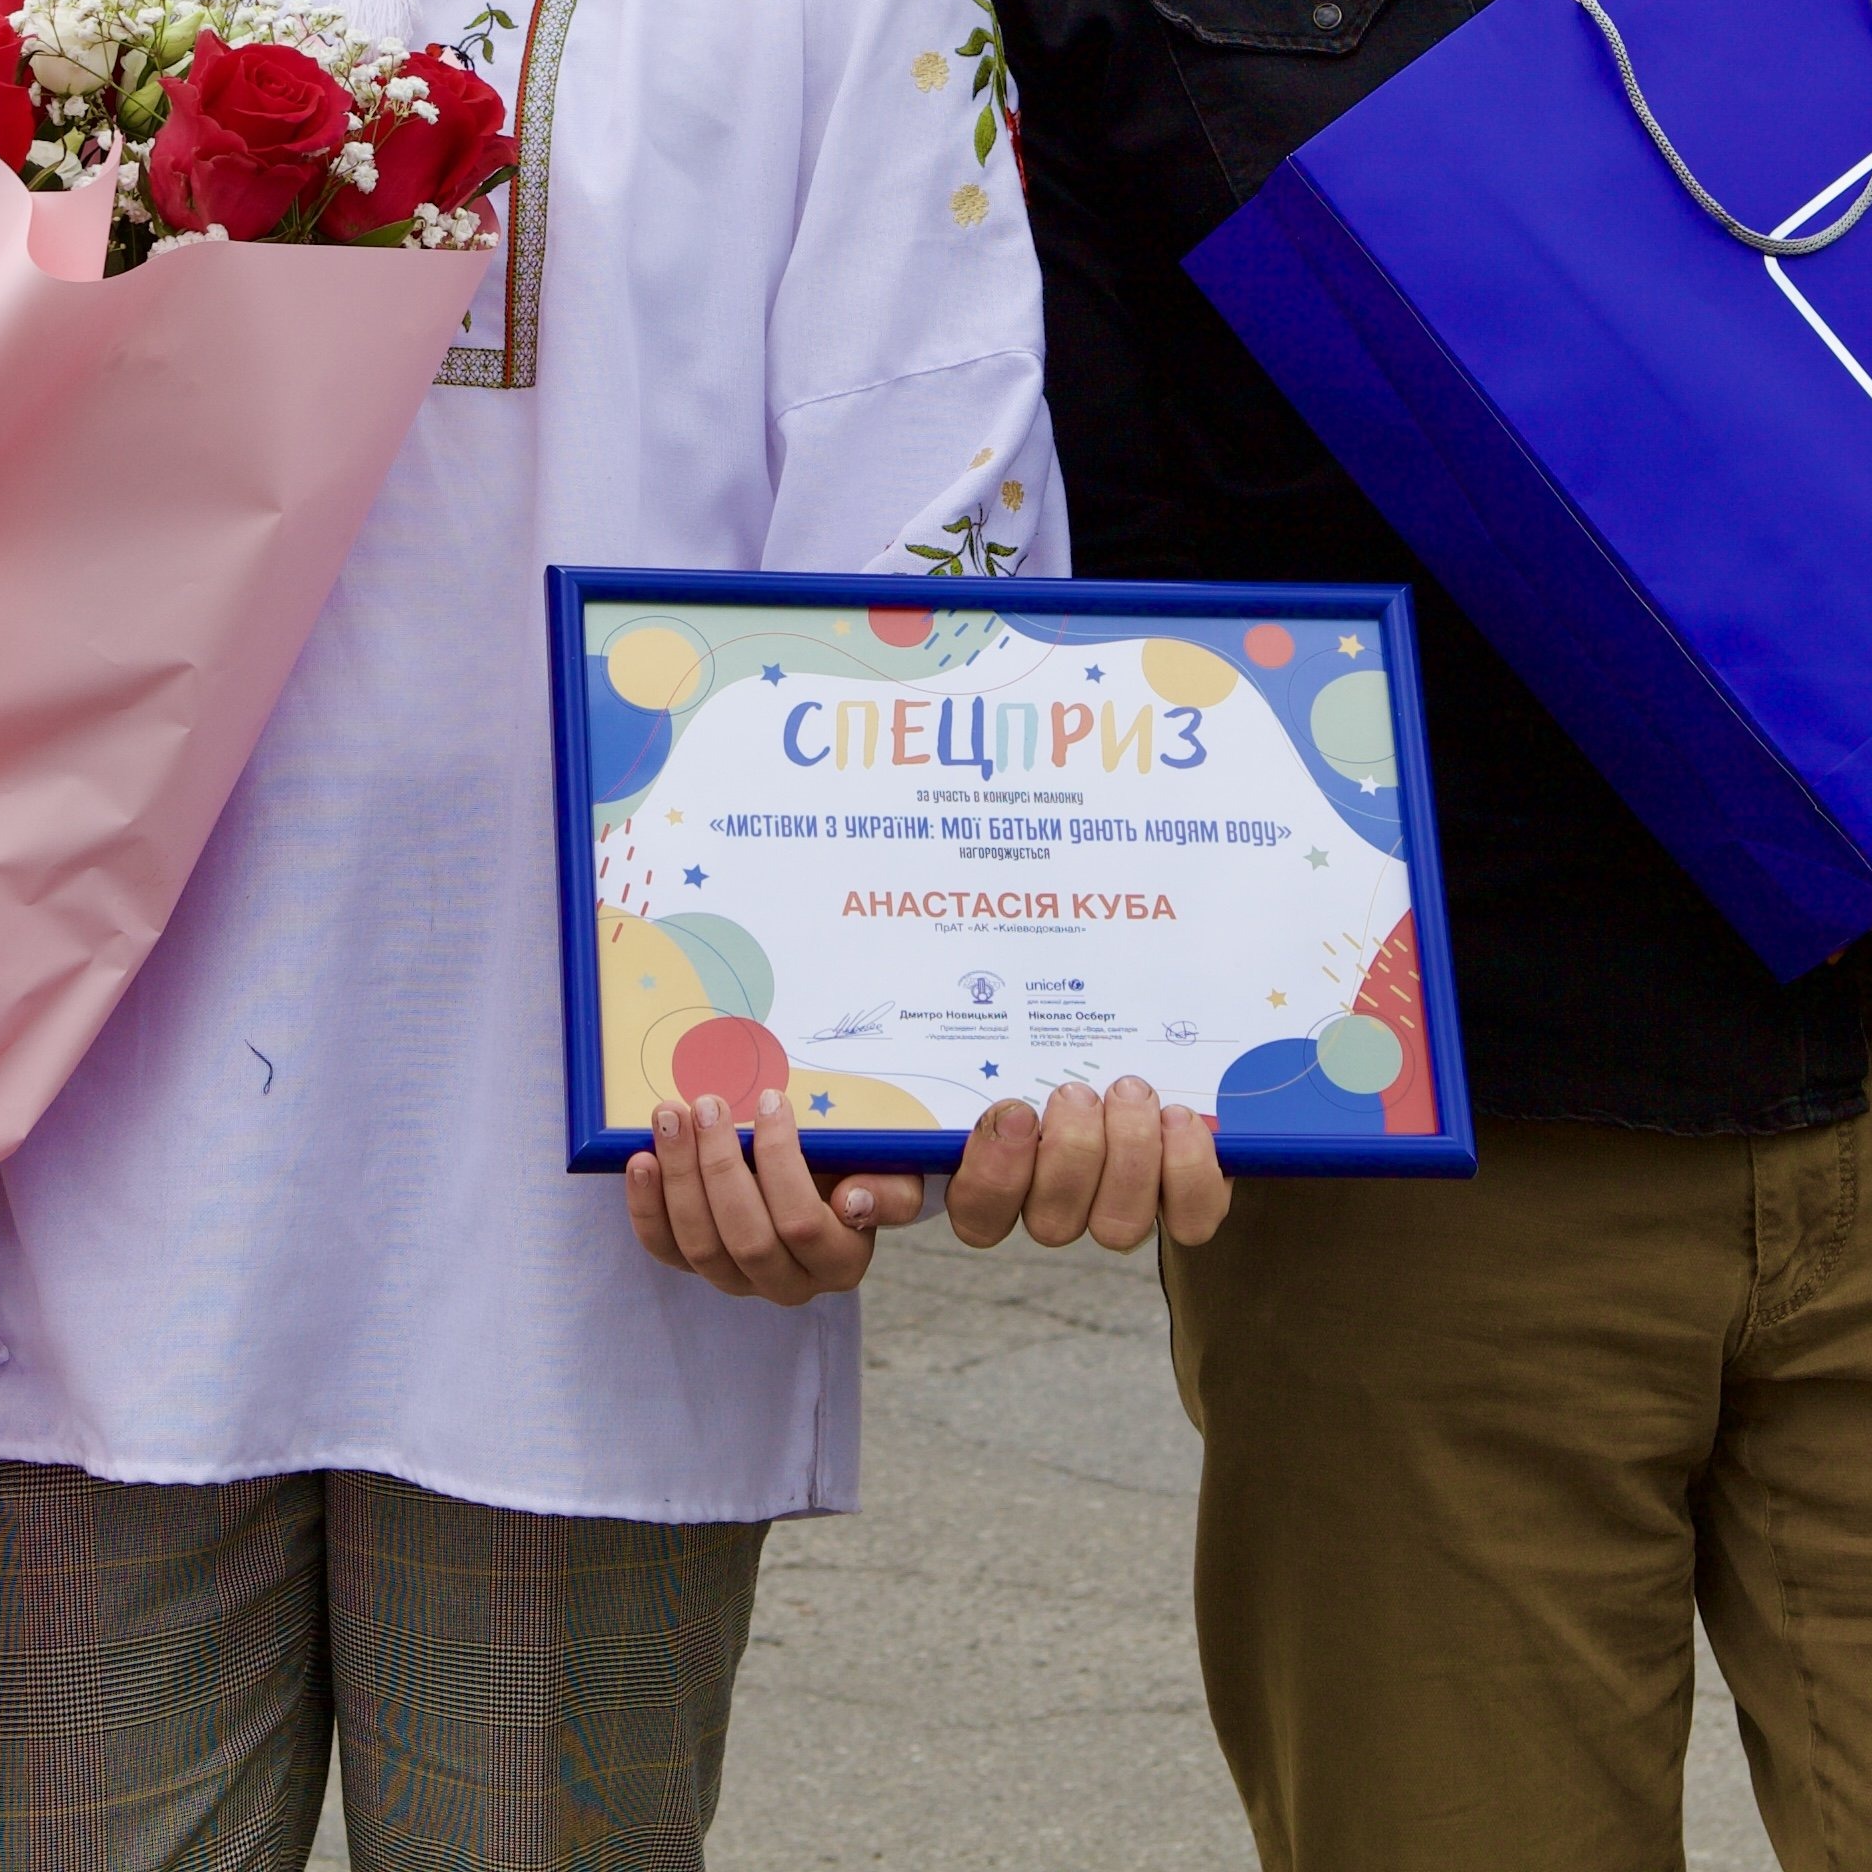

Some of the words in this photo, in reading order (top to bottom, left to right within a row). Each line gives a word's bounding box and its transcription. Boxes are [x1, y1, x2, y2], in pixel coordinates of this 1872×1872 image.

[783, 695, 1208, 782] СПЕЦПРИЗ
[842, 891, 1059, 918] АНАСТАСІЯ
[1072, 893, 1176, 920] КУБА
[1026, 979, 1066, 991] unicef
[900, 1010, 943, 1021] Дмитро
[946, 1011, 1007, 1020] Новицький
[1029, 1011, 1072, 1020] Ніколас
[1076, 1011, 1115, 1022] Осберт
